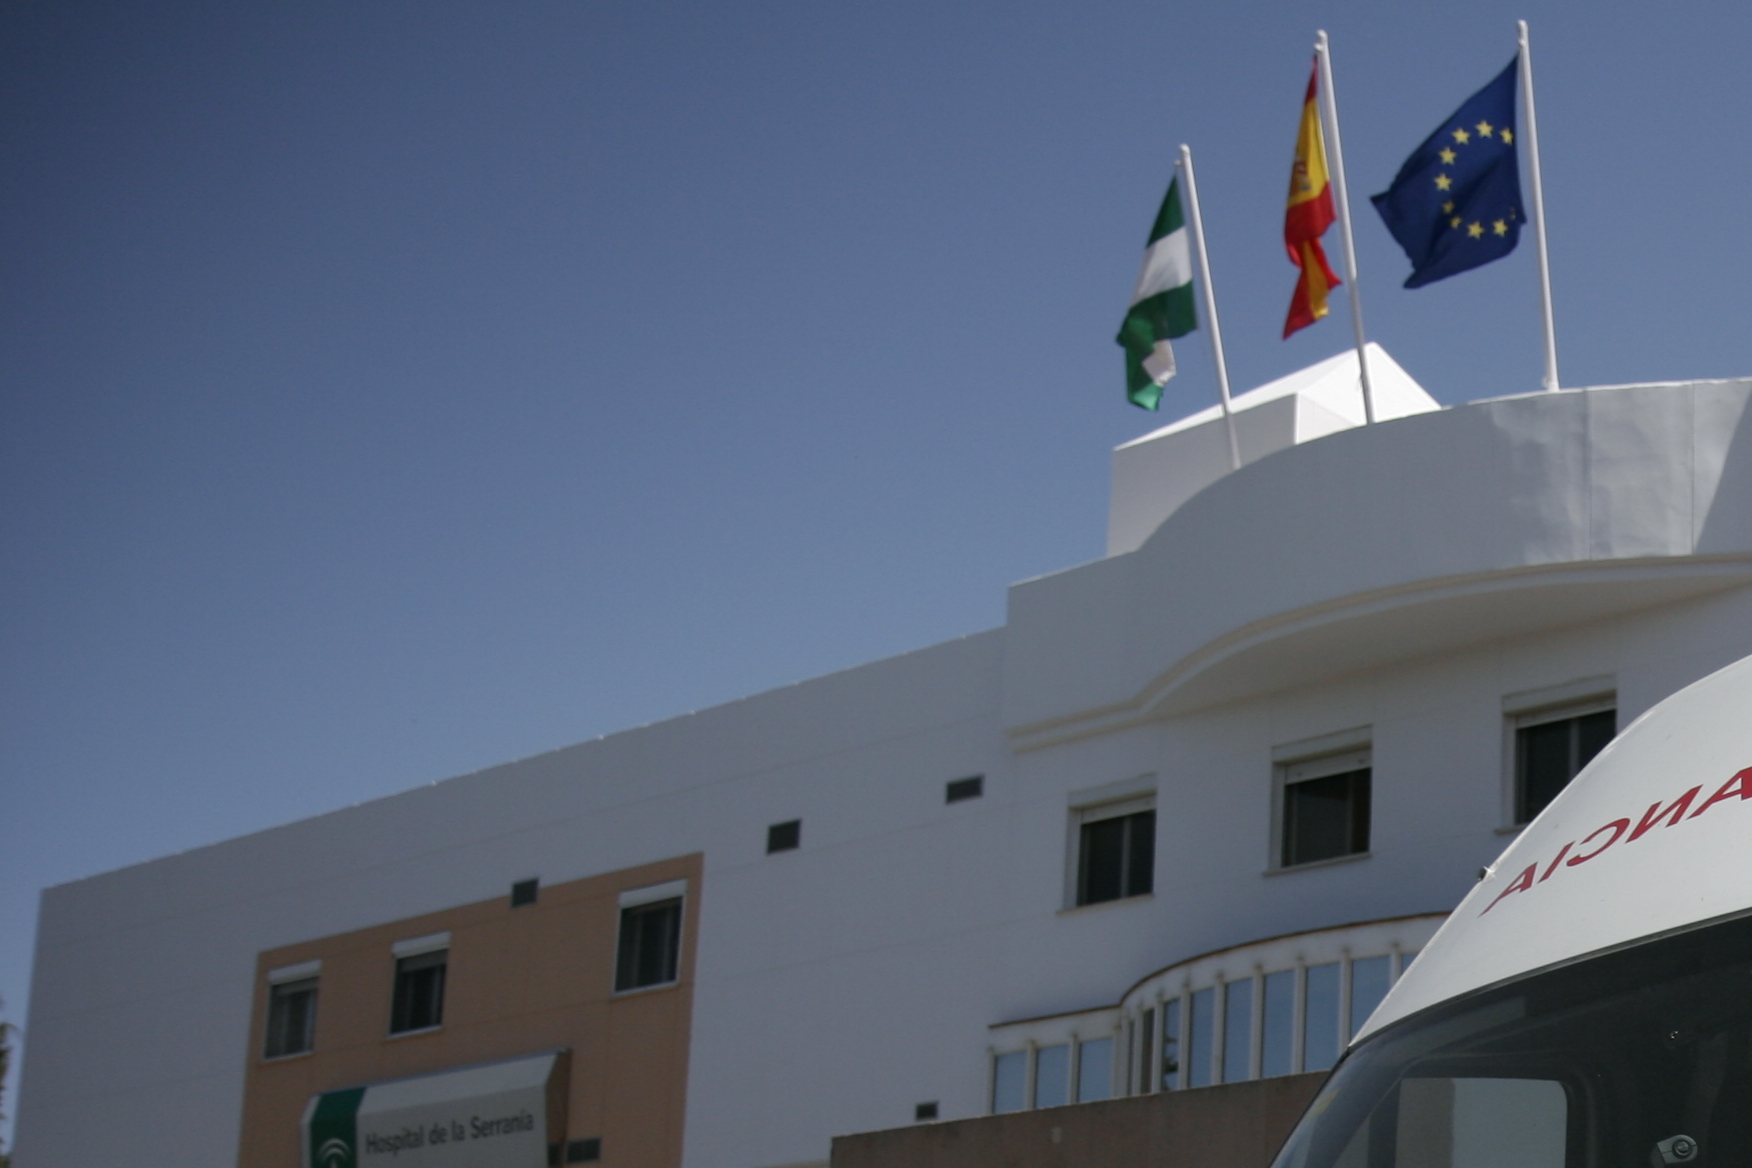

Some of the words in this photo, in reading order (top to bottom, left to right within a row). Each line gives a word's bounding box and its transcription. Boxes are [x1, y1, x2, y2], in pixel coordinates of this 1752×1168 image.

[366, 1125, 424, 1156] Hospital
[429, 1122, 448, 1145] de
[451, 1119, 465, 1142] la
